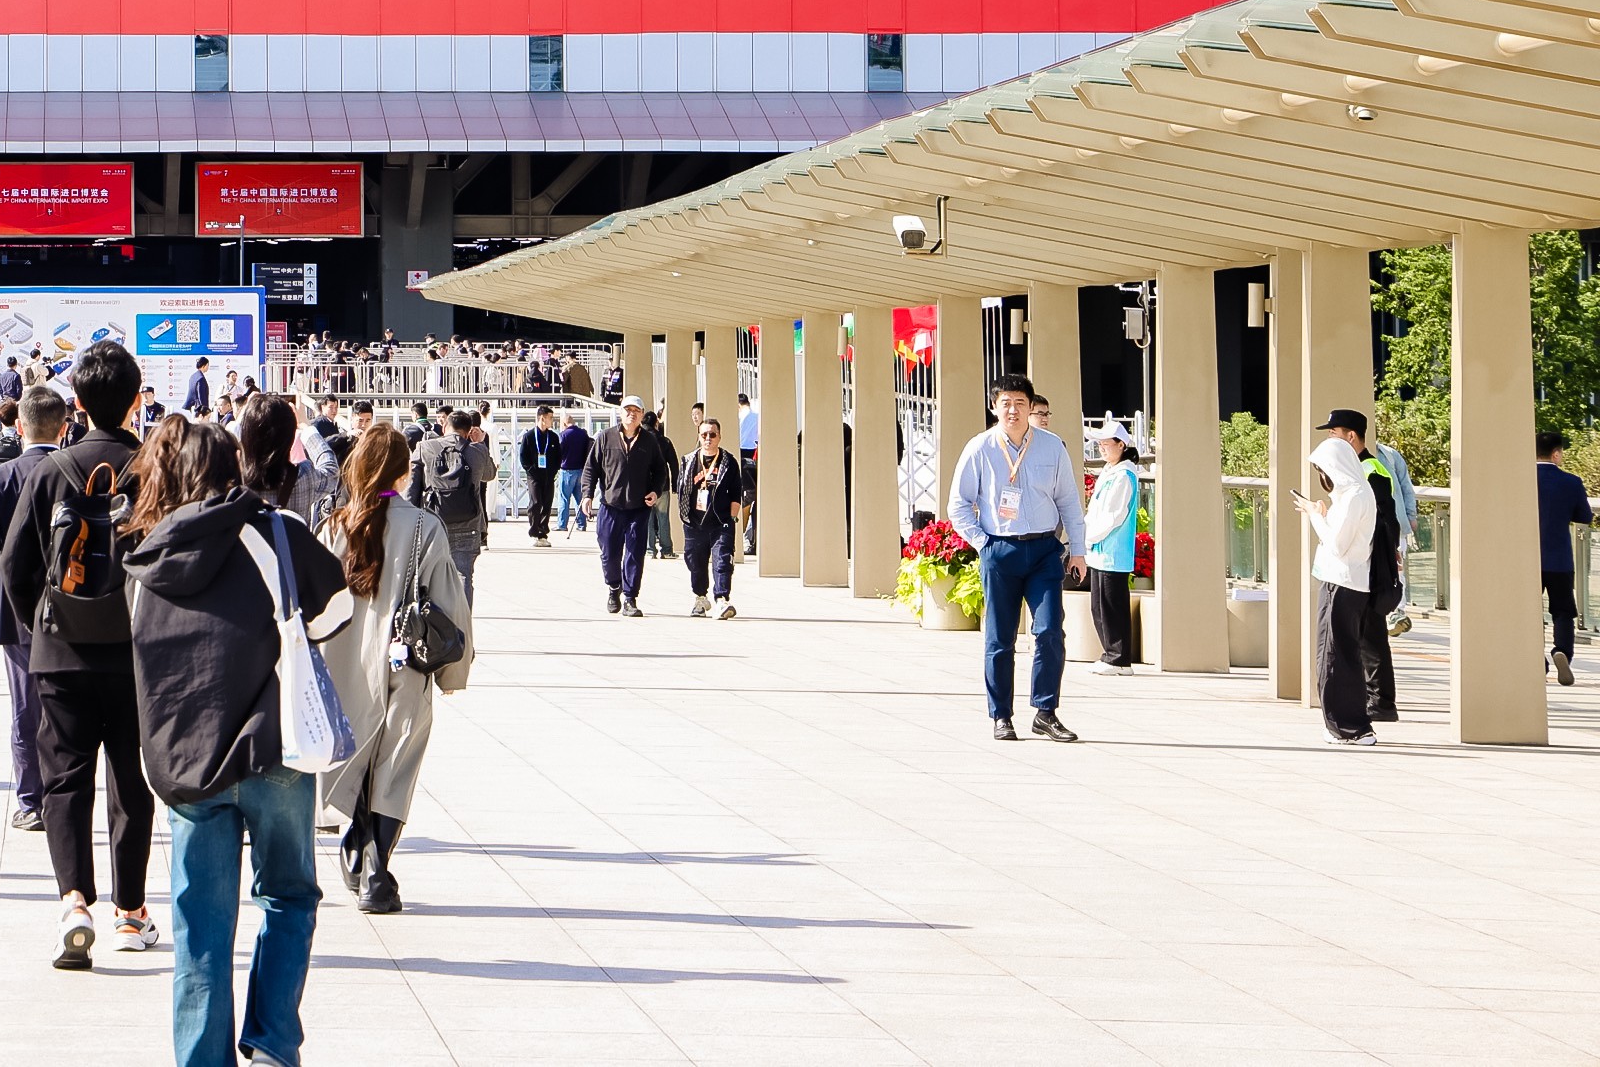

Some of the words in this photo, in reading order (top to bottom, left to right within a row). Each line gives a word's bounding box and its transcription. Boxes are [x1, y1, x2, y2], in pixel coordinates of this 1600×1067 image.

[220, 188, 338, 197] 第七届中国国际进口博览会
[160, 299, 224, 307] 欢迎索取进博会信息
